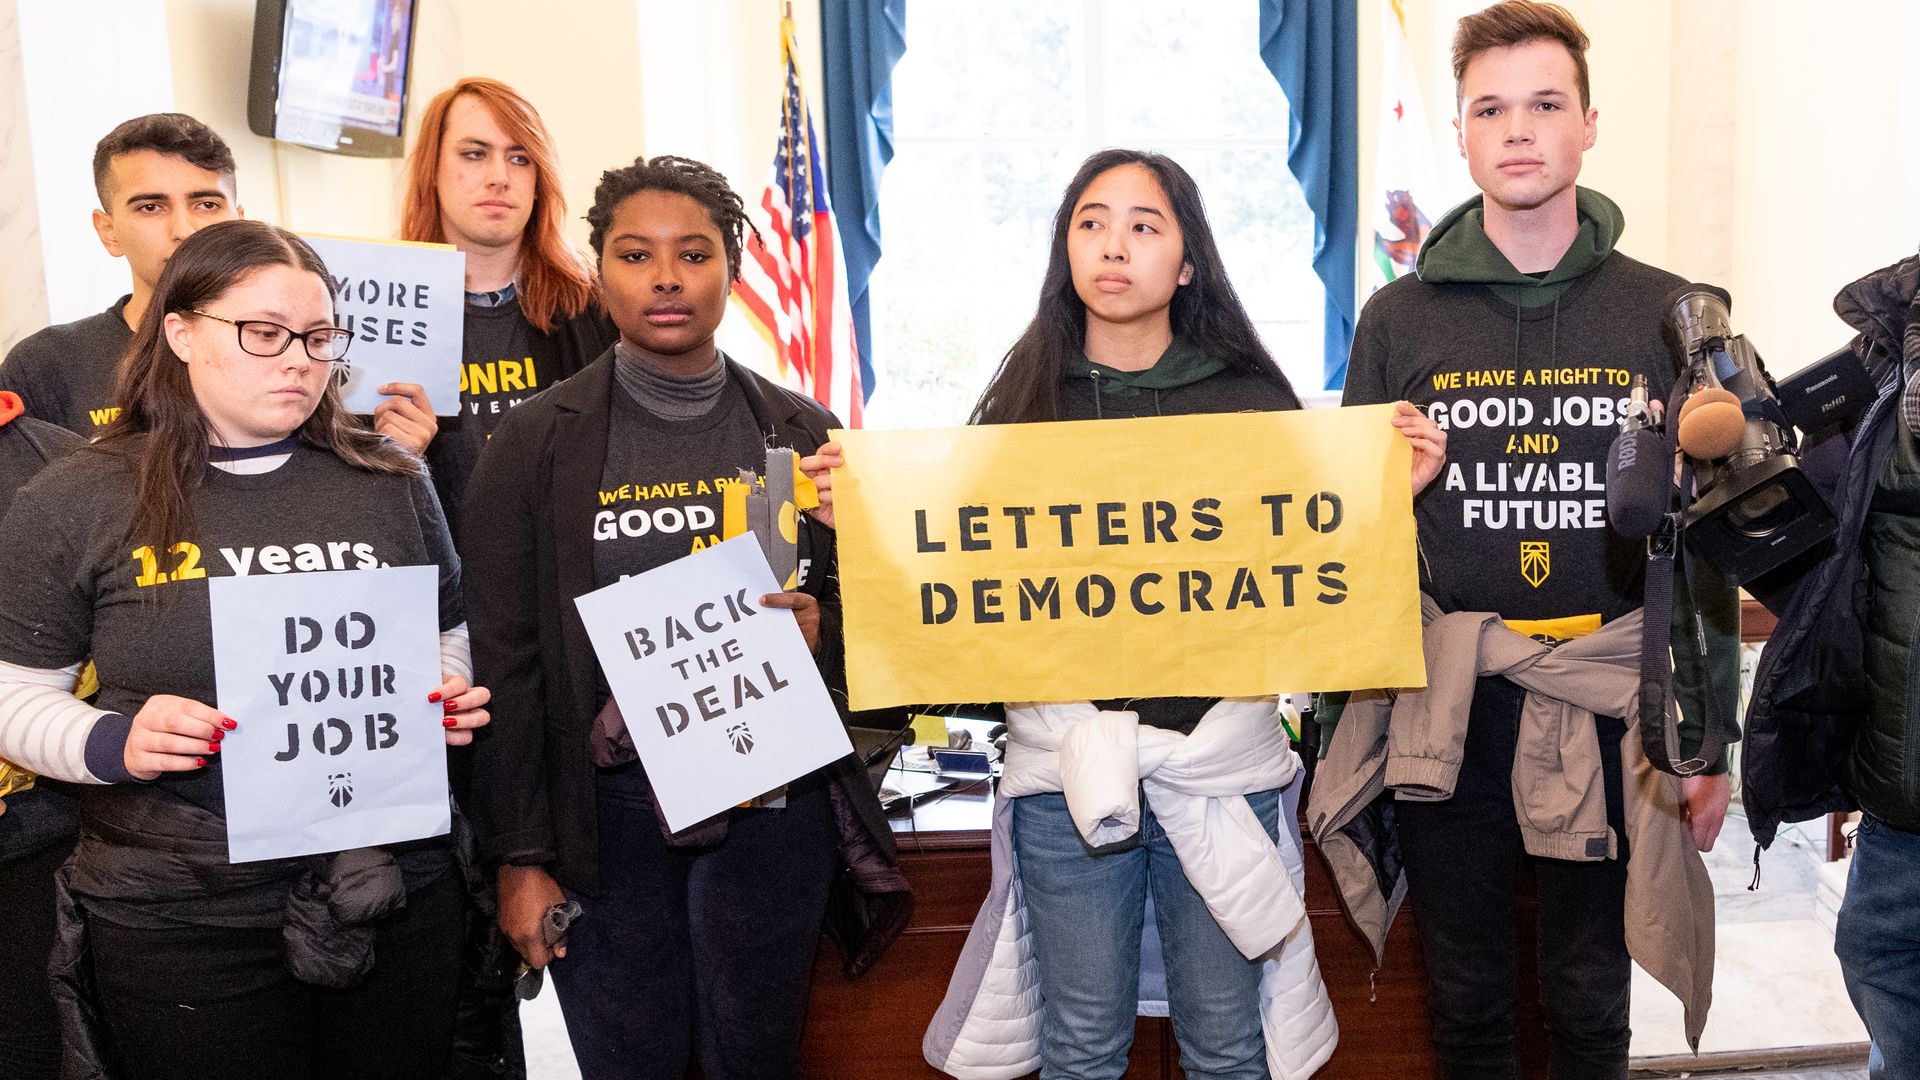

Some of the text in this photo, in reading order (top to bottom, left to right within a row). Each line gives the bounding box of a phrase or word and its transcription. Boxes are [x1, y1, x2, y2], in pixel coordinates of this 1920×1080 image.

[1433, 368, 1630, 390] WE HAVE A RIGHT TO
[1805, 374, 1838, 394] Panasonic
[1428, 398, 1534, 430] GOOD
[1505, 434, 1560, 454] AND
[598, 484, 631, 506] WE
[635, 482, 692, 501] HAVE
[696, 479, 711, 495] A
[1445, 462, 1607, 492] A LIVABL
[593, 505, 716, 541] GOOD
[915, 491, 1344, 554] LETTERS TO
[1463, 499, 1606, 530] FUTURE
[132, 541, 206, 587] 12
[920, 561, 1348, 625] DEMOCRATS
[284, 611, 376, 655] DO
[624, 587, 757, 661] BACK
[671, 638, 744, 681] THE
[267, 664, 397, 706] YOUR
[656, 660, 789, 738] DEAL
[274, 713, 399, 761] JOB
